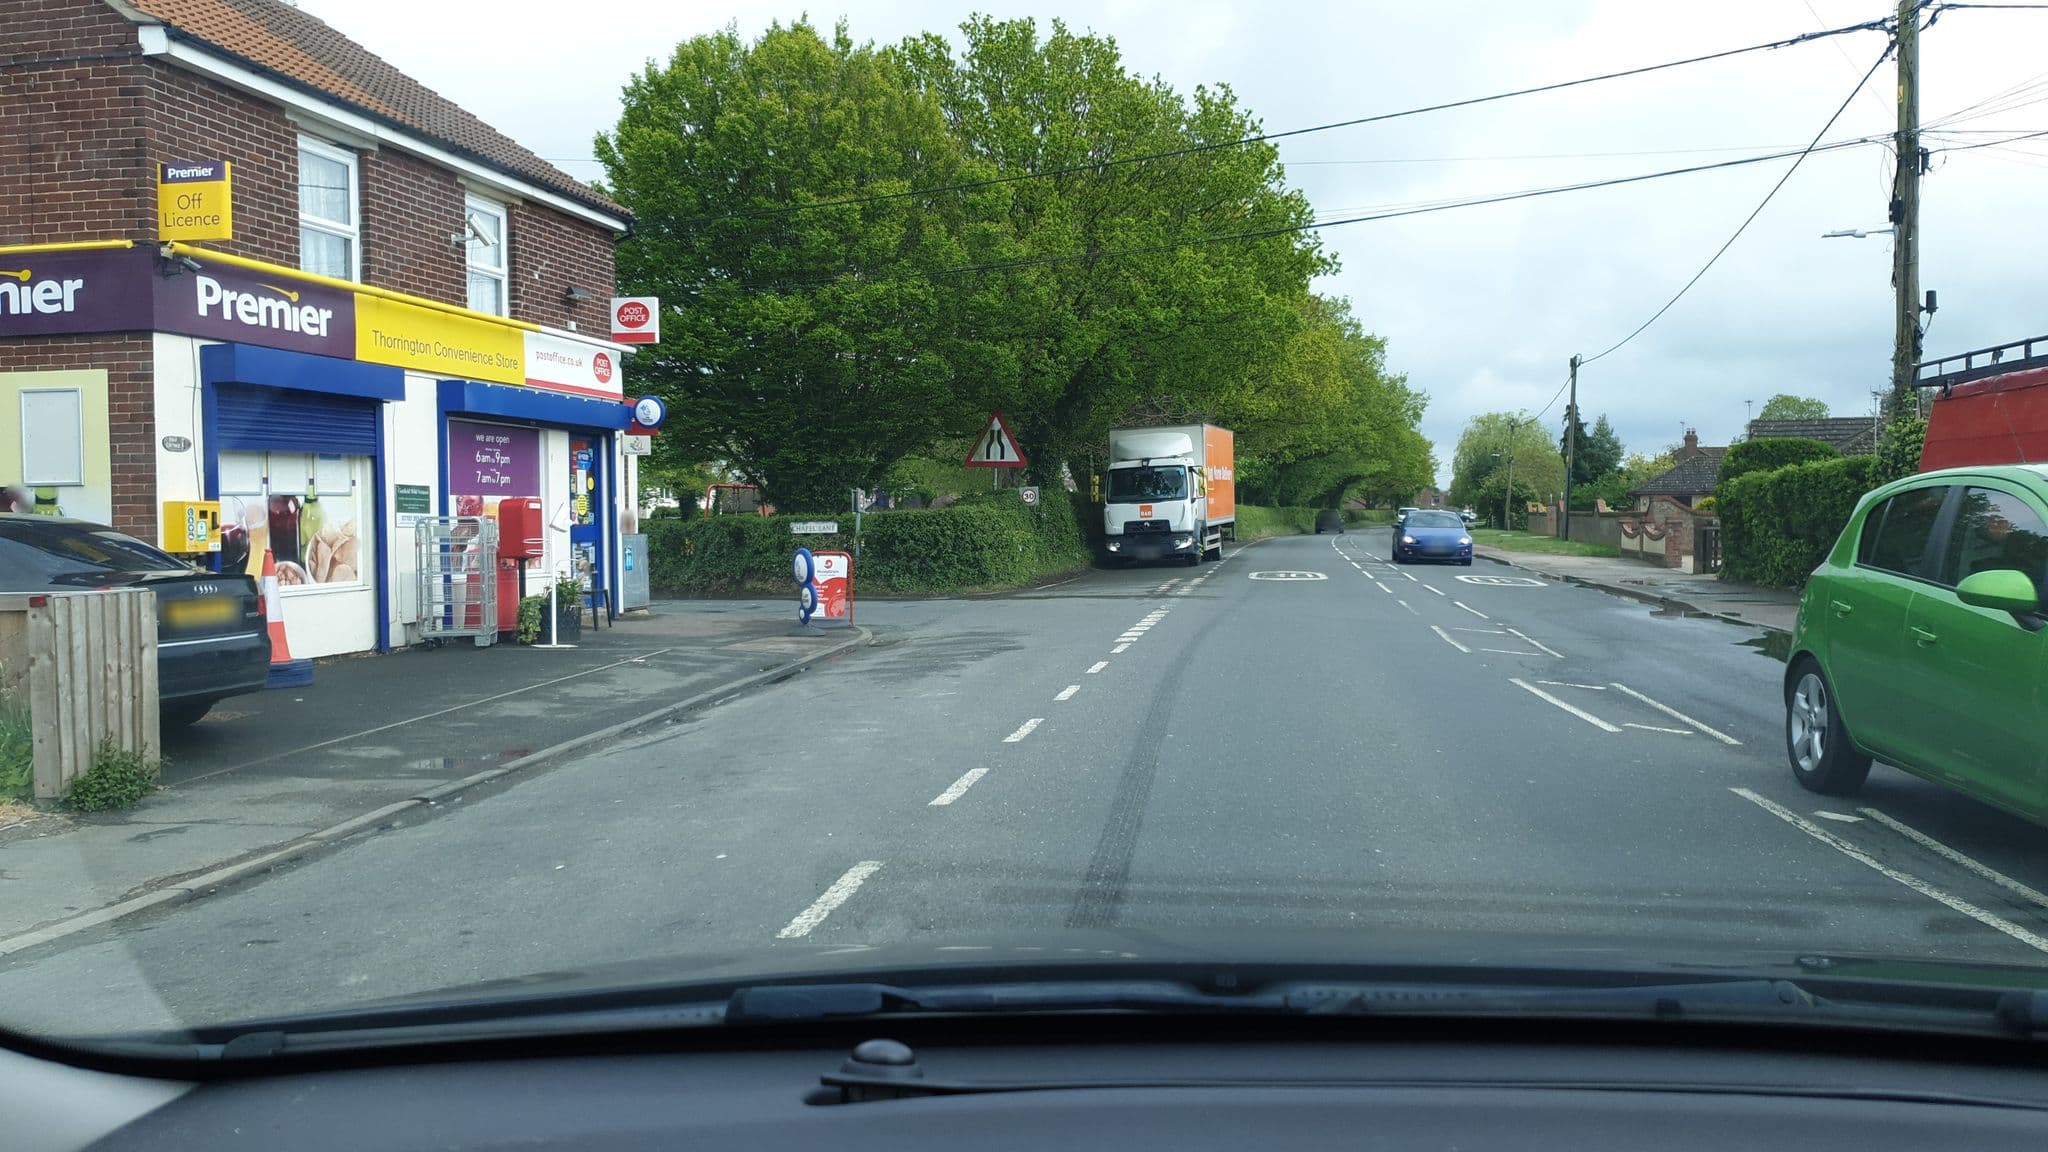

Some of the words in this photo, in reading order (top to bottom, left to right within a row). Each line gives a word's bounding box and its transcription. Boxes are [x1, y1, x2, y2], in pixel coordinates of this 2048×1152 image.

[167, 165, 214, 179] Premier
[177, 193, 203, 211] Off
[164, 211, 221, 228] Licence
[196, 275, 333, 337] Premier
[623, 306, 643, 315] POST
[619, 314, 647, 323] OFFICE
[372, 330, 432, 357] Thorrington
[434, 341, 494, 367] Convenience
[495, 353, 519, 370] Store
[535, 349, 584, 368] postoffice.co.uk
[596, 358, 610, 368] POST
[594, 367, 612, 378] OFFICE
[496, 436, 510, 446] open
